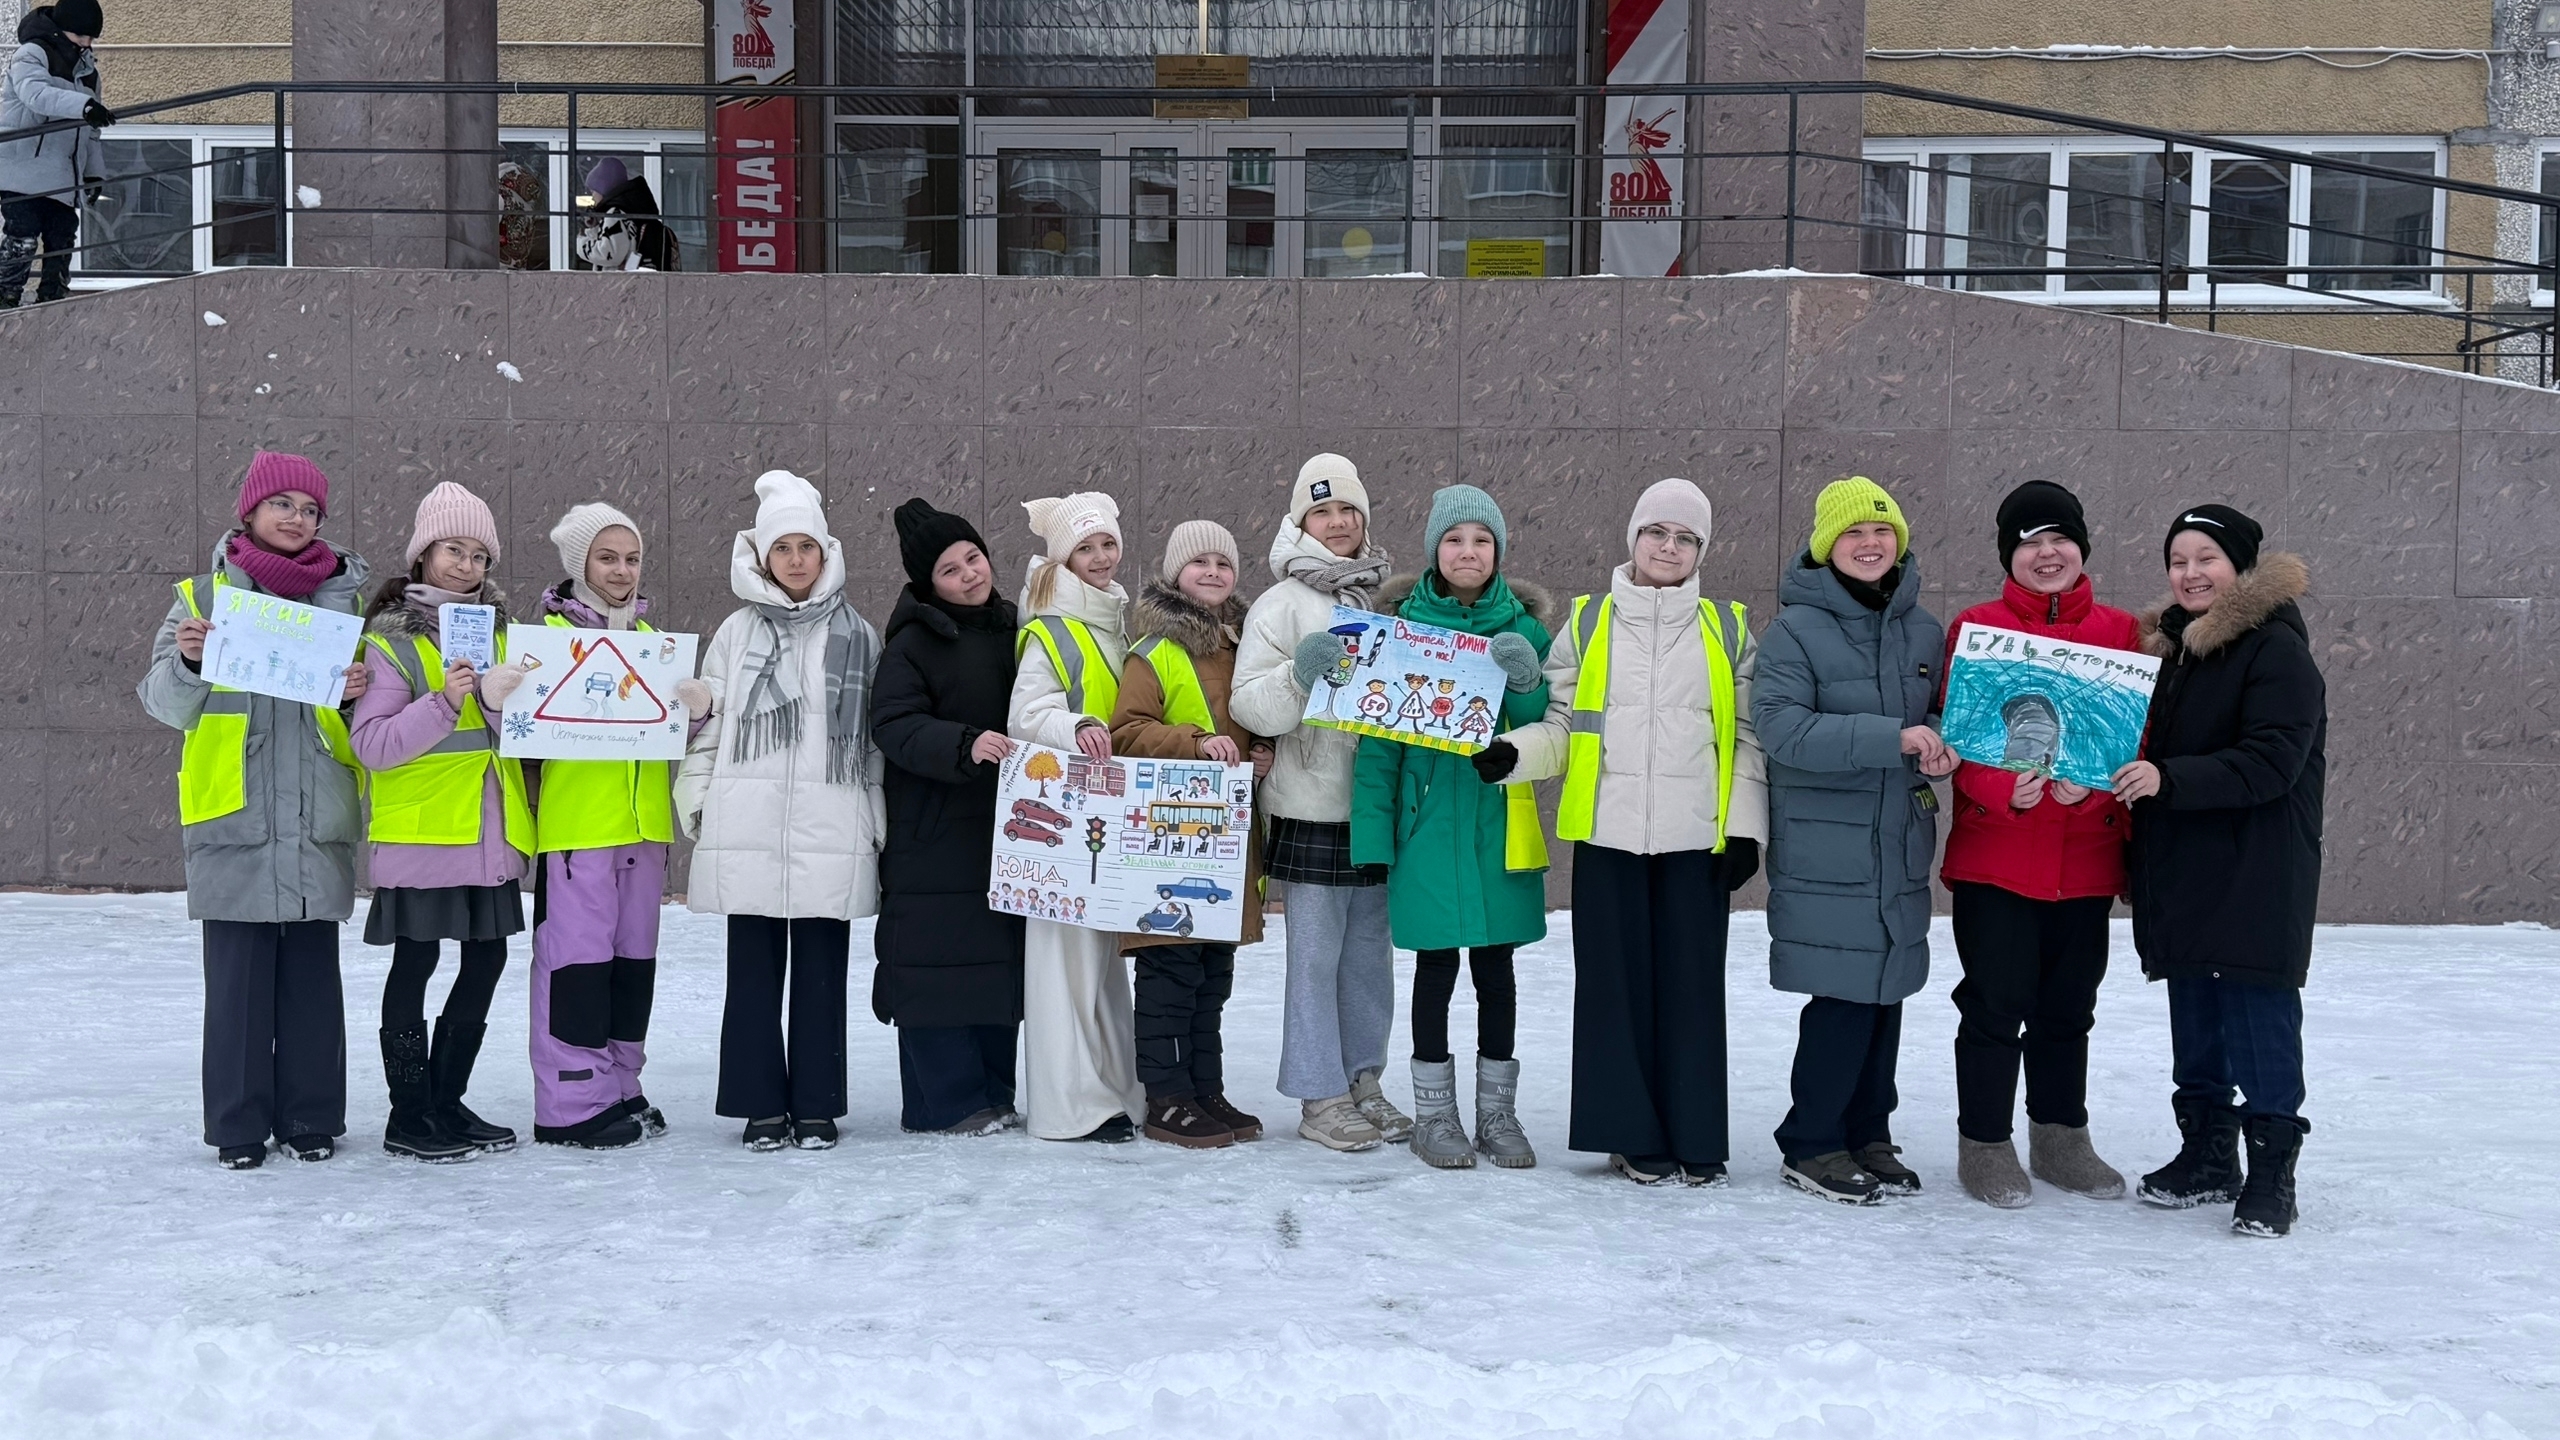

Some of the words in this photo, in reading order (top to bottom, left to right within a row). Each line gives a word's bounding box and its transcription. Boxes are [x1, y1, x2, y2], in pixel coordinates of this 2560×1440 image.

[733, 33, 756, 54] 80
[733, 57, 775, 70] ПОБЕДА!
[1610, 172, 1644, 201] 80
[226, 591, 314, 627] ЯРКИЙ
[1394, 620, 1449, 648] Водитель,
[1450, 633, 1488, 655] ПОМНИ
[1435, 649, 1456, 663] нас!
[1365, 699, 1386, 712] 50
[997, 855, 1068, 887] ЮИД
[1428, 1089, 1451, 1099] BACK
